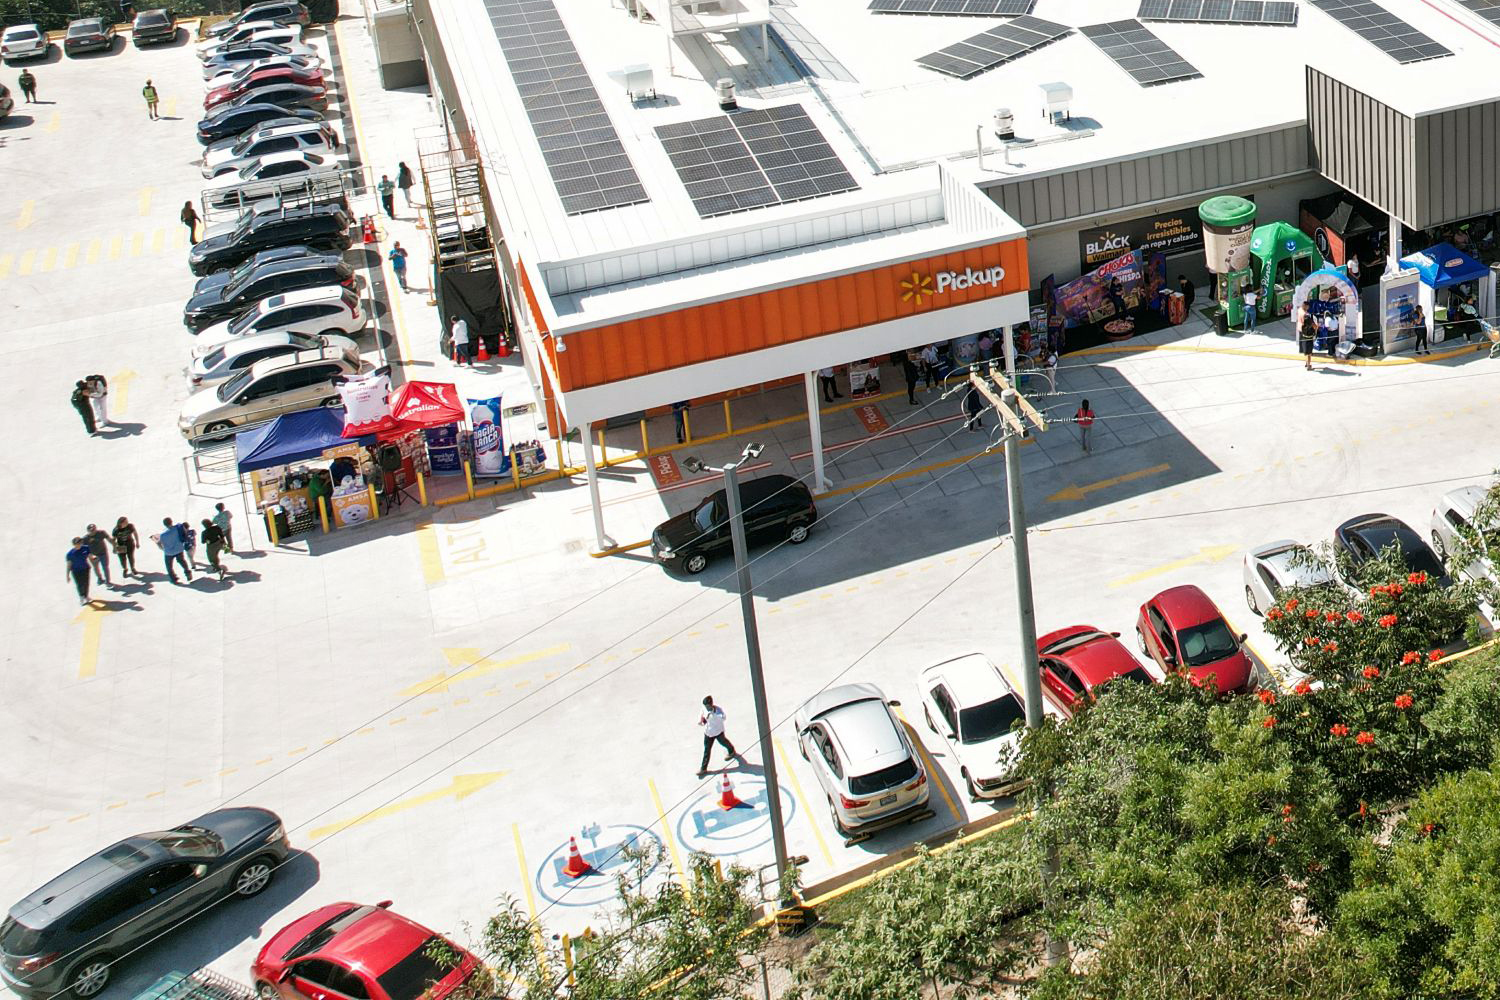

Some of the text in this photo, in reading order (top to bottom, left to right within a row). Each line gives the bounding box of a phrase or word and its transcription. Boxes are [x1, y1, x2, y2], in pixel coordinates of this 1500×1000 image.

[1154, 219, 1183, 230] Precios
[1147, 226, 1191, 241] irresistibles
[1150, 239, 1167, 249] ropa
[1167, 238, 1172, 246] y
[1172, 233, 1199, 244] calzado
[1086, 235, 1130, 254] BLACK
[936, 266, 1006, 294] Pickup
[397, 404, 440, 420] ustralian
